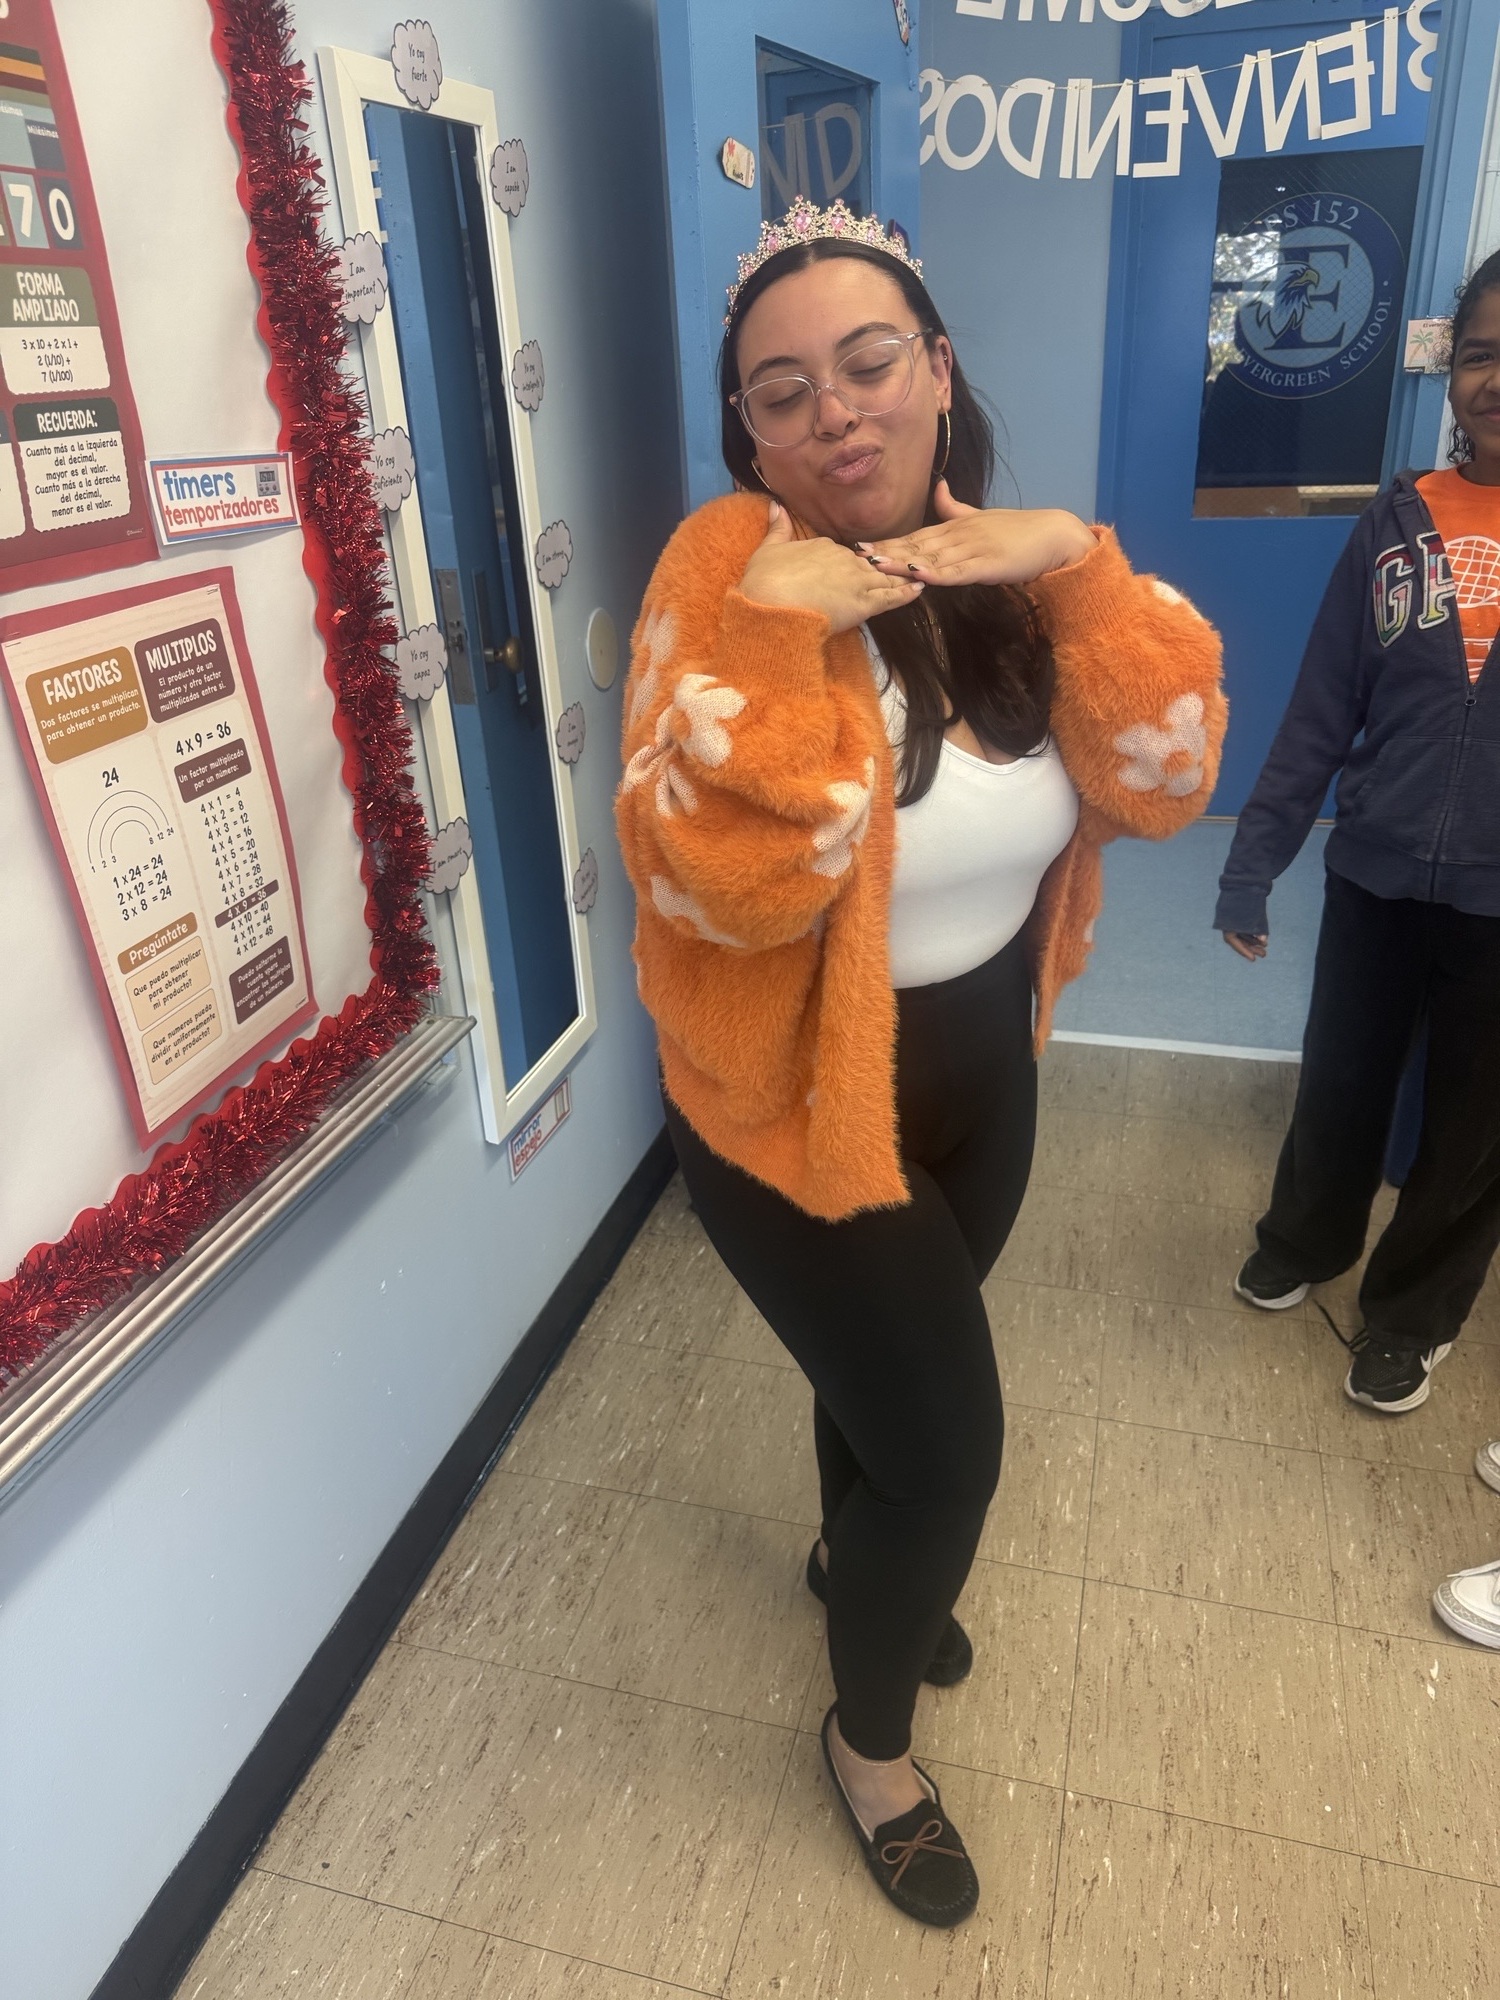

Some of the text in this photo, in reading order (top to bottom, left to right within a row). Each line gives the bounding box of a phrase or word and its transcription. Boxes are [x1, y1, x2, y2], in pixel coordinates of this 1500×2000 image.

[8, 184, 75, 240] 7 0
[1264, 199, 1359, 232] PS 152
[16, 271, 65, 296] FORMA
[349, 262, 366, 277] I am
[345, 280, 376, 303] important
[12, 299, 80, 322] AMPLIADO
[22, 339, 28, 350] 3
[36, 338, 45, 349] 10
[54, 338, 60, 349] 2
[67, 338, 72, 349] 1
[1339, 296, 1392, 371] SCHOOL
[37, 355, 43, 366] 2
[44, 353, 65, 368] (1/10)
[41, 369, 74, 383] 7 (1/100)
[36, 409, 98, 433] RECUERDA:
[26, 437, 118, 458] Cuanto más a la izquierda
[54, 452, 97, 467] del decimal,
[46, 464, 108, 482] mayor es el valor.
[375, 455, 395, 469] Yo soy
[35, 474, 121, 495] Cuanto más a la derecha
[60, 489, 102, 503] del decimal,
[163, 470, 236, 501] timers
[52, 499, 113, 517] menor es el valor.
[165, 496, 280, 527] temporizadores
[145, 629, 217, 674] MULTIPLOS
[410, 649, 418, 663] Yo
[42, 658, 123, 706] FACTORES
[158, 661, 214, 687] El producto de un
[158, 671, 222, 700] número y otro factor
[40, 688, 139, 730] Dos factores se multiplican
[159, 691, 200, 713] multiplicados
[201, 684, 218, 696] entre
[46, 701, 141, 745] para obtener un producto.
[176, 740, 184, 756] 4
[194, 732, 203, 748] 9
[206, 732, 214, 740] =
[216, 721, 232, 739] 36
[102, 767, 120, 788] 24
[178, 748, 245, 784] Un factor multiplicado
[194, 779, 205, 792] por
[206, 774, 215, 784] un
[200, 803, 207, 814] 4
[217, 796, 222, 806] 1
[235, 787, 241, 797] 4
[157, 831, 165, 841] 12
[166, 826, 175, 837] 24
[91, 866, 96, 874] 1
[102, 860, 108, 869] 2
[111, 855, 117, 864] 3
[112, 876, 120, 889] 1
[128, 865, 142, 882] 24
[143, 863, 150, 871] =
[151, 854, 164, 870] 24
[117, 892, 125, 906] 2
[133, 881, 146, 896] 12
[155, 870, 168, 885] 24
[122, 908, 130, 921] 3
[140, 898, 148, 911] 8
[159, 885, 172, 901] 24
[129, 923, 188, 965] Pregúntate
[133, 949, 202, 997] Que puedo multiplicar
[148, 970, 189, 1002] para obtener
[152, 978, 192, 1010] mi producto?
[151, 1013, 216, 1063] dividir uniformemente
[153, 1004, 213, 1049] Que numeros puedo
[165, 1026, 211, 1066] en el producto?
[514, 1113, 542, 1154] mirror
[515, 1129, 543, 1167] espejo
